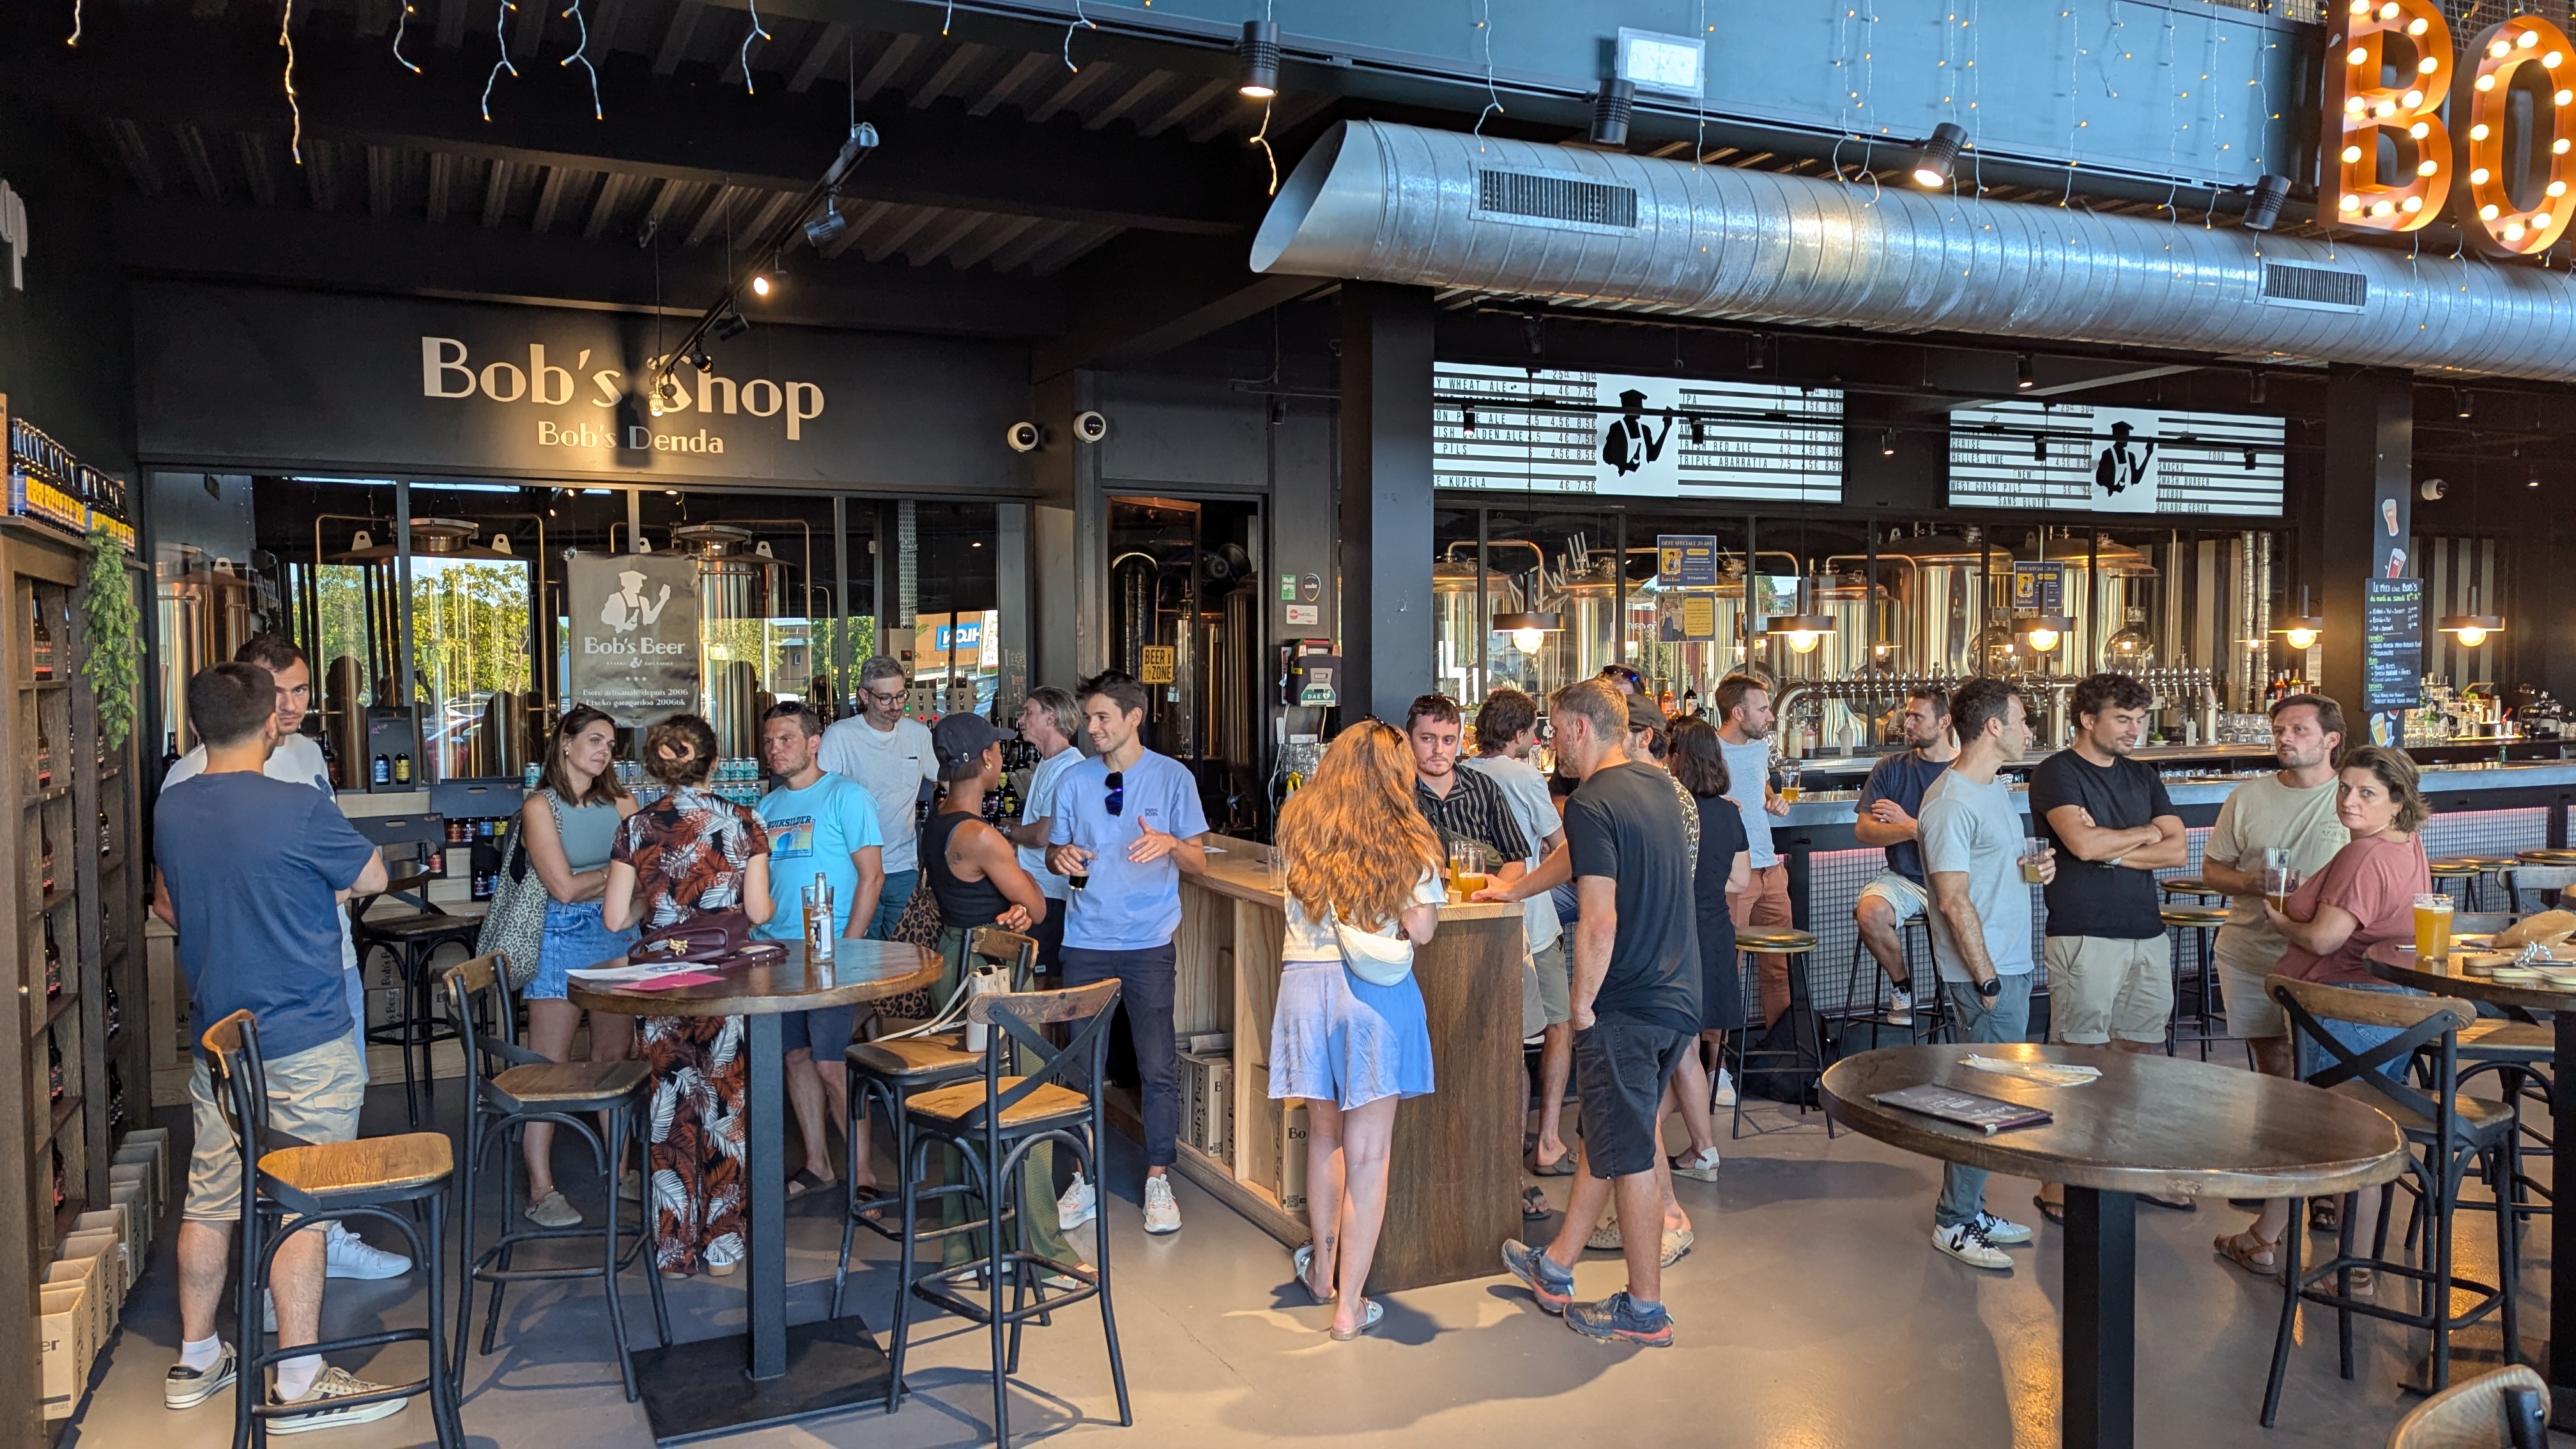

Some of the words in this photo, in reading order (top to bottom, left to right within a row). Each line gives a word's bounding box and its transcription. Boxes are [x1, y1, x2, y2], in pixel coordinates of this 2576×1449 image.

[422, 336, 623, 408] Bob's
[1449, 378, 1480, 390] WHEAT
[1490, 381, 1506, 392] ALE
[1683, 394, 1697, 405] IPA
[1489, 413, 1506, 424] ALE
[538, 421, 617, 448] Bob's
[629, 425, 724, 454] Denda
[1506, 431, 1523, 442] ALE
[1443, 443, 1467, 456] PILS
[1713, 441, 1729, 452] RED
[1736, 443, 1751, 453] ALE
[1952, 438, 1980, 450] CERISE
[1952, 452, 1980, 463] HELLES
[1986, 454, 2004, 465] LIME
[2208, 451, 2225, 461] FOOD
[1679, 456, 1712, 466] TRIPLE
[1719, 457, 1768, 469] ABARRATIA
[2158, 462, 2184, 473] SNACKS
[2018, 469, 2032, 479] NEW
[1449, 475, 1486, 488] KUPELA
[2158, 475, 2179, 485] SMASH
[2184, 477, 2210, 486] BURGER
[1951, 481, 1970, 491] WEST
[1975, 482, 1998, 493] COAST
[2004, 483, 2021, 493] PILS
[1998, 496, 2016, 506] SANS
[2157, 502, 2182, 512] SALADE
[585, 637, 636, 655] Bob's
[640, 637, 686, 655] Beer
[1144, 649, 1165, 664] BEER
[1151, 666, 1172, 680] ZONE
